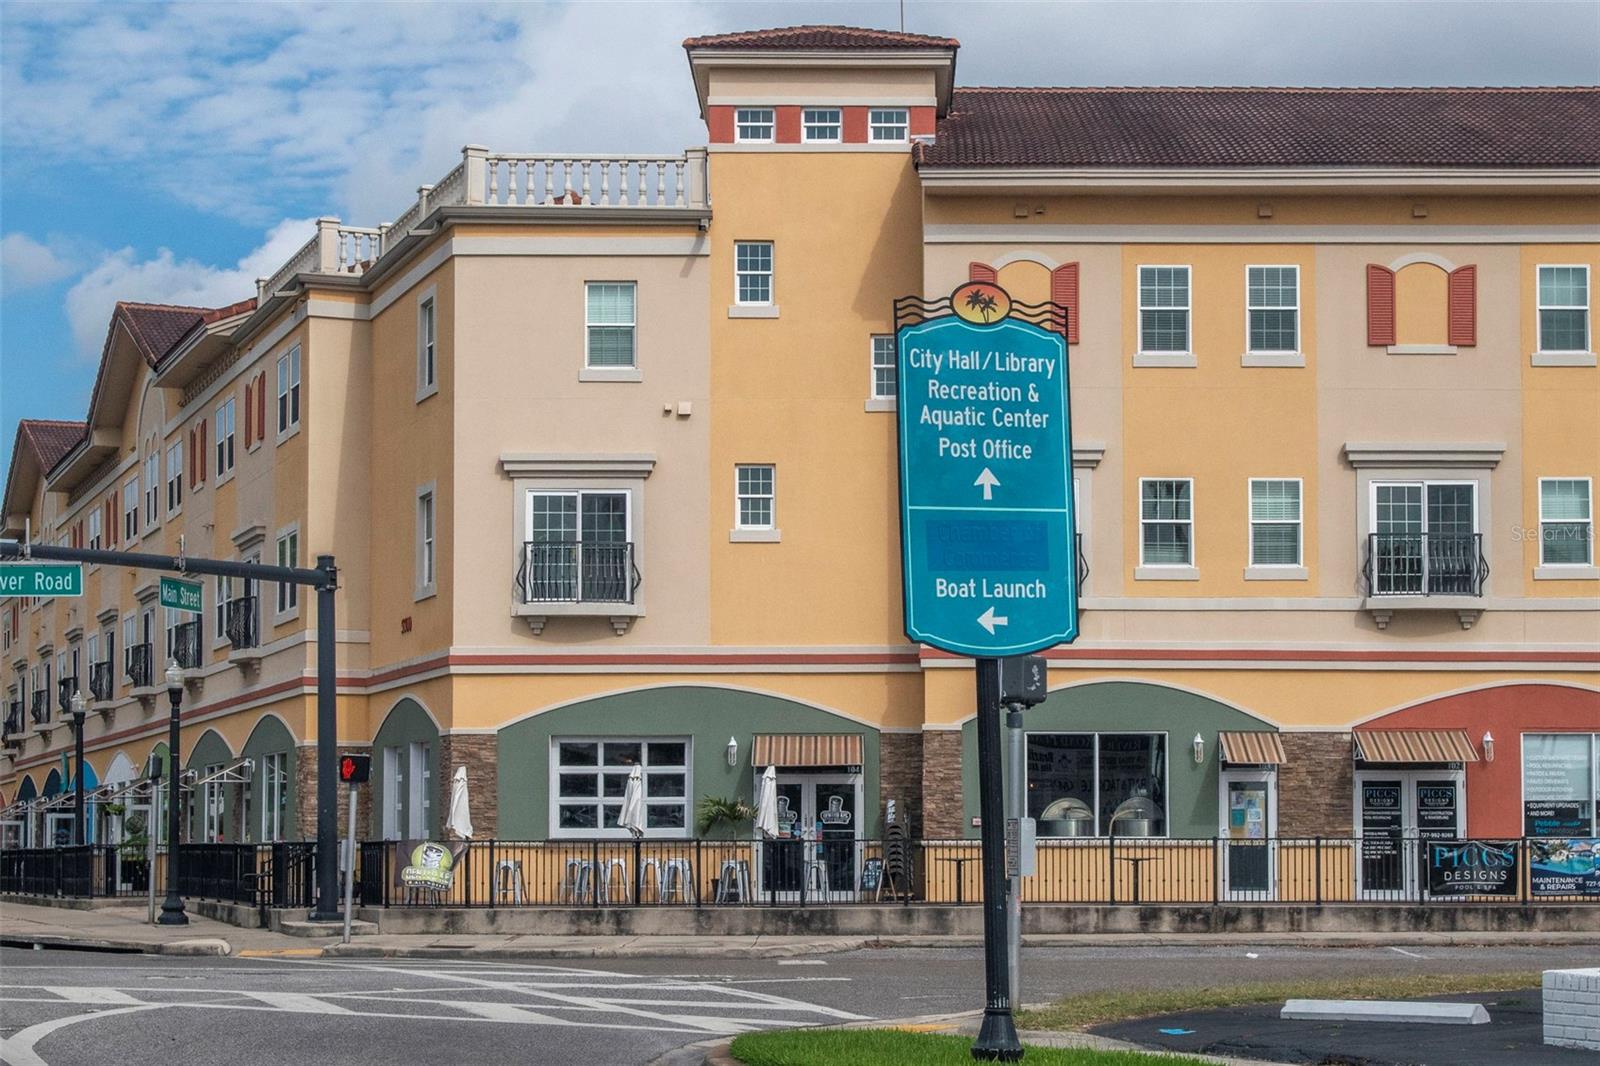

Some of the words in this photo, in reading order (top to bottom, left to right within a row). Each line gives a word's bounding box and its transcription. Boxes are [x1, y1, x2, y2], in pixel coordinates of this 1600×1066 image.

[909, 347, 943, 375] City
[928, 379, 1022, 402] Recreation
[1027, 383, 1040, 403] &
[920, 404, 986, 431] Aquatic
[992, 407, 1049, 428] Center
[939, 437, 977, 458] Post
[982, 438, 1032, 459] Office
[35, 572, 72, 590] Road
[936, 578, 978, 598] Boat
[982, 578, 1046, 599] Launch
[162, 583, 177, 603] Main
[180, 587, 201, 608] Street
[1366, 789, 1398, 798] PICCS
[1420, 789, 1453, 798] PICCS
[1433, 846, 1514, 868] PICCS
[1444, 870, 1508, 881] DESIGNS
[1532, 877, 1583, 885] MAINTENANCE
